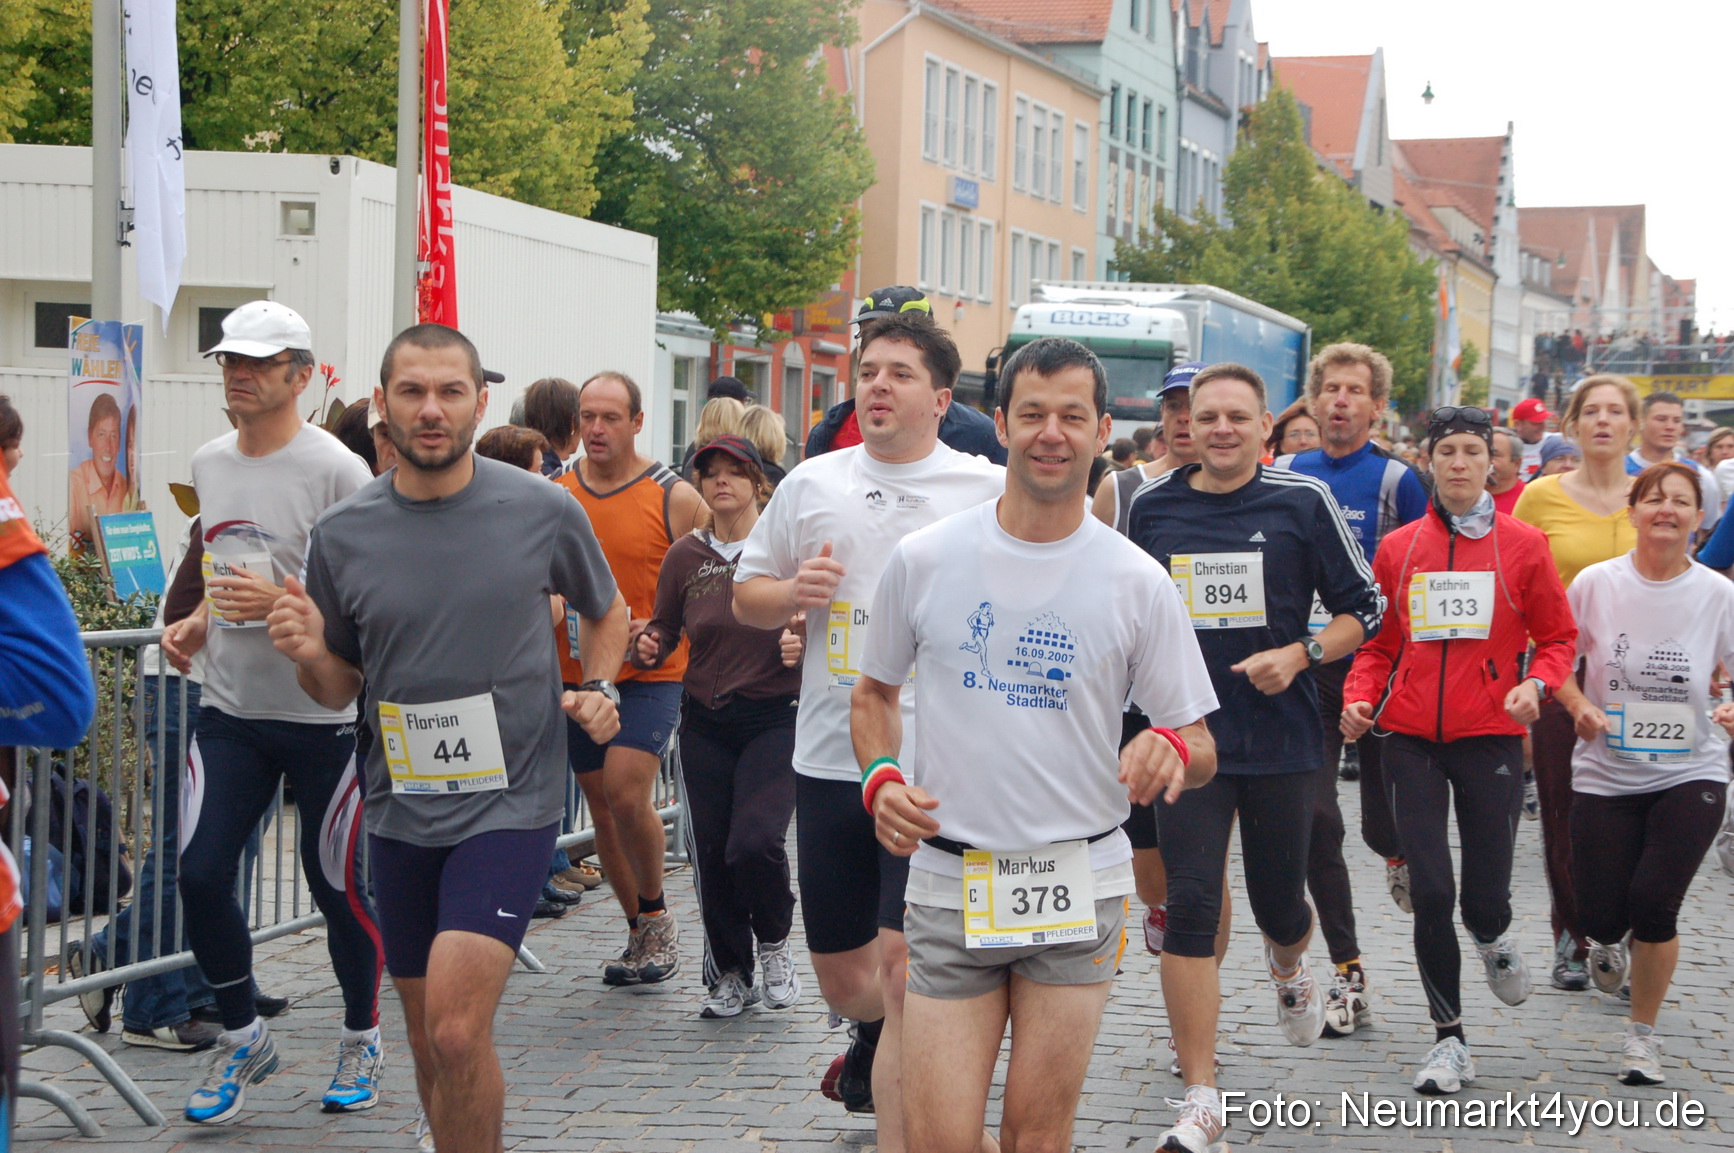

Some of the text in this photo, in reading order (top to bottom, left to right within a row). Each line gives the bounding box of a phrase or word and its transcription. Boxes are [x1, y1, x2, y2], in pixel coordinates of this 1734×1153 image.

[1051, 310, 1130, 327] BOCK
[1652, 379, 1711, 393] START
[1195, 562, 1248, 576] Christian
[1429, 578, 1470, 591] Kathrin
[1205, 583, 1248, 604] 894
[1438, 598, 1478, 617] 133
[1015, 646, 1075, 664] 16.09.2007
[1646, 662, 1690, 672] 21.09.2008
[963, 671, 1068, 699] 8. Neumarkter
[1609, 679, 1688, 695] 9. Neumarkter
[1642, 693, 1689, 703] Stadtlauf
[406, 713, 459, 730] Florian
[1632, 722, 1685, 740] 2222
[388, 737, 471, 763] C 44
[460, 774, 505, 787] PFLEIDERER
[998, 856, 1055, 876] Markus
[969, 885, 1071, 916] C 378
[1046, 926, 1095, 938] PFLEIDERER
